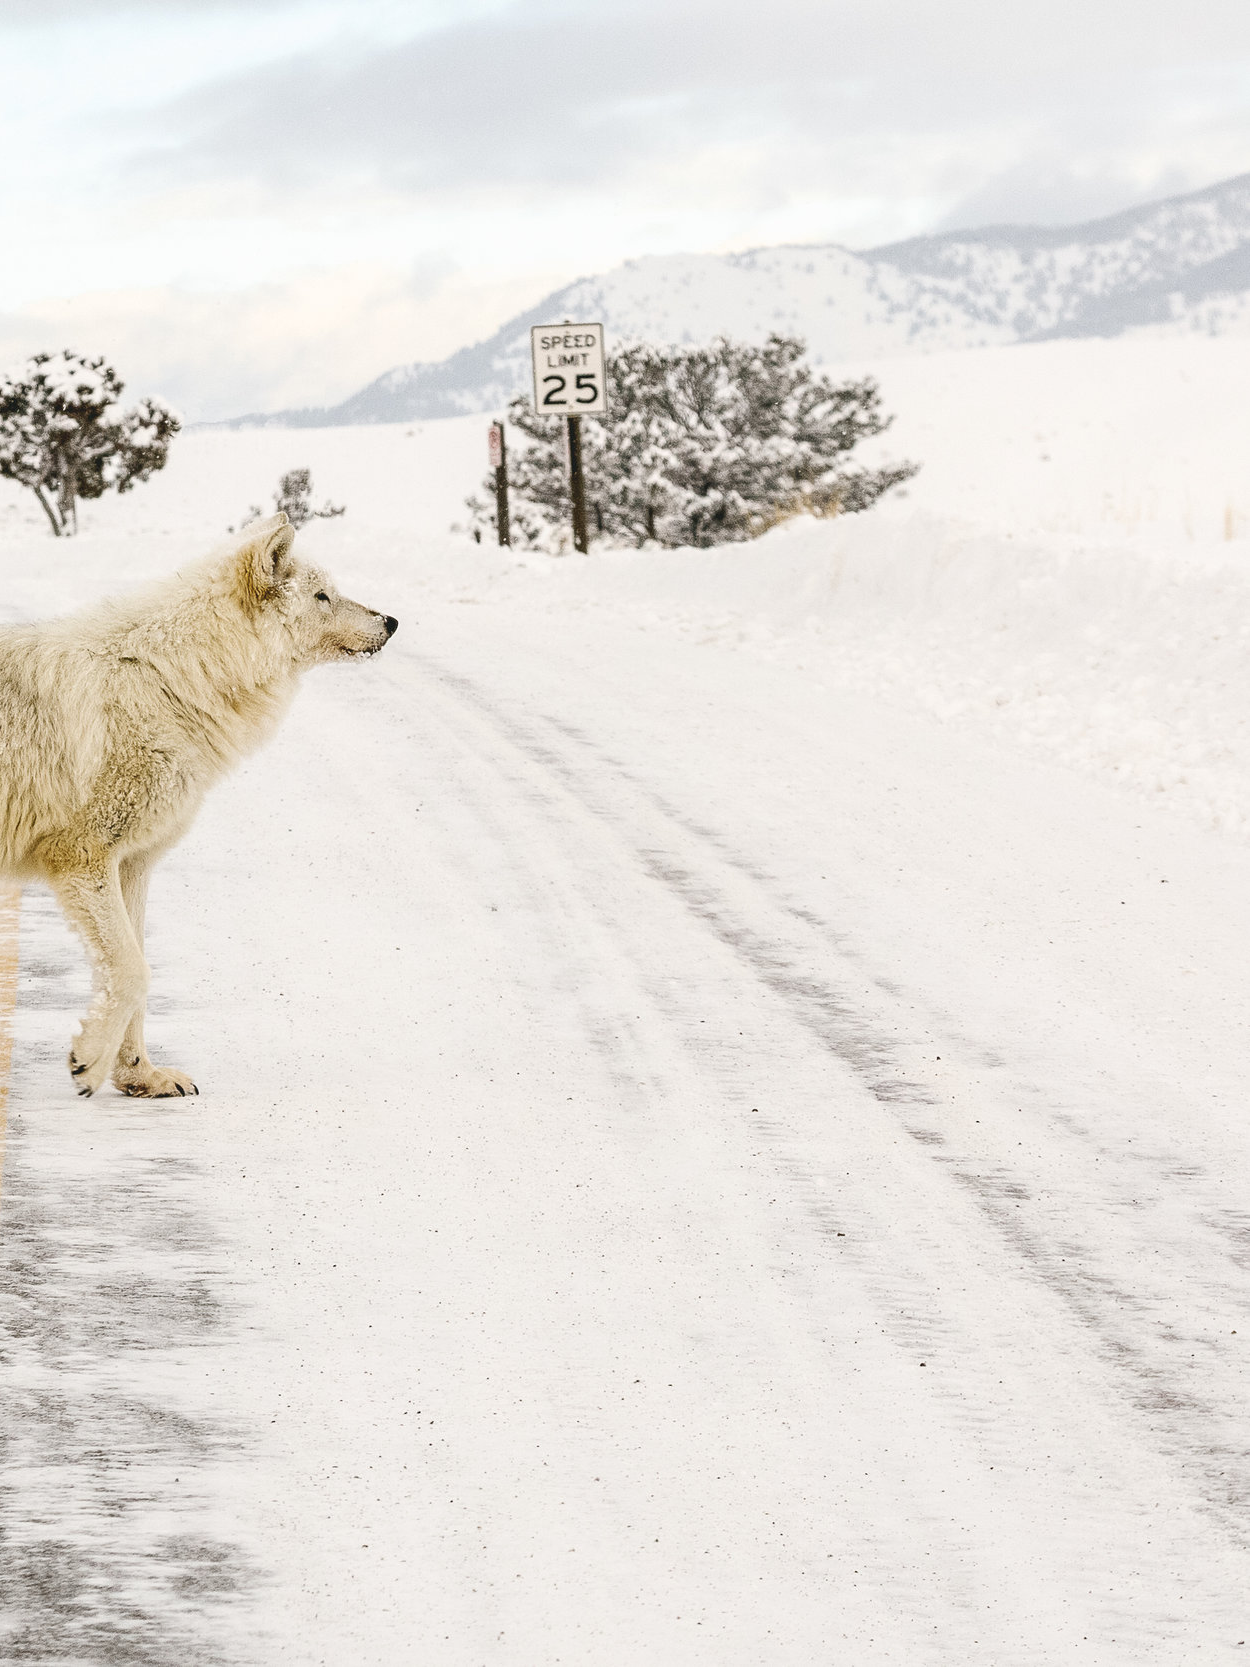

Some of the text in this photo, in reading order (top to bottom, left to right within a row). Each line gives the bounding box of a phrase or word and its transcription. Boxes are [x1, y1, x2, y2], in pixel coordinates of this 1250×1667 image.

[541, 335, 597, 350] SPEED
[547, 353, 589, 368] LIMIT
[543, 374, 598, 405] 25
